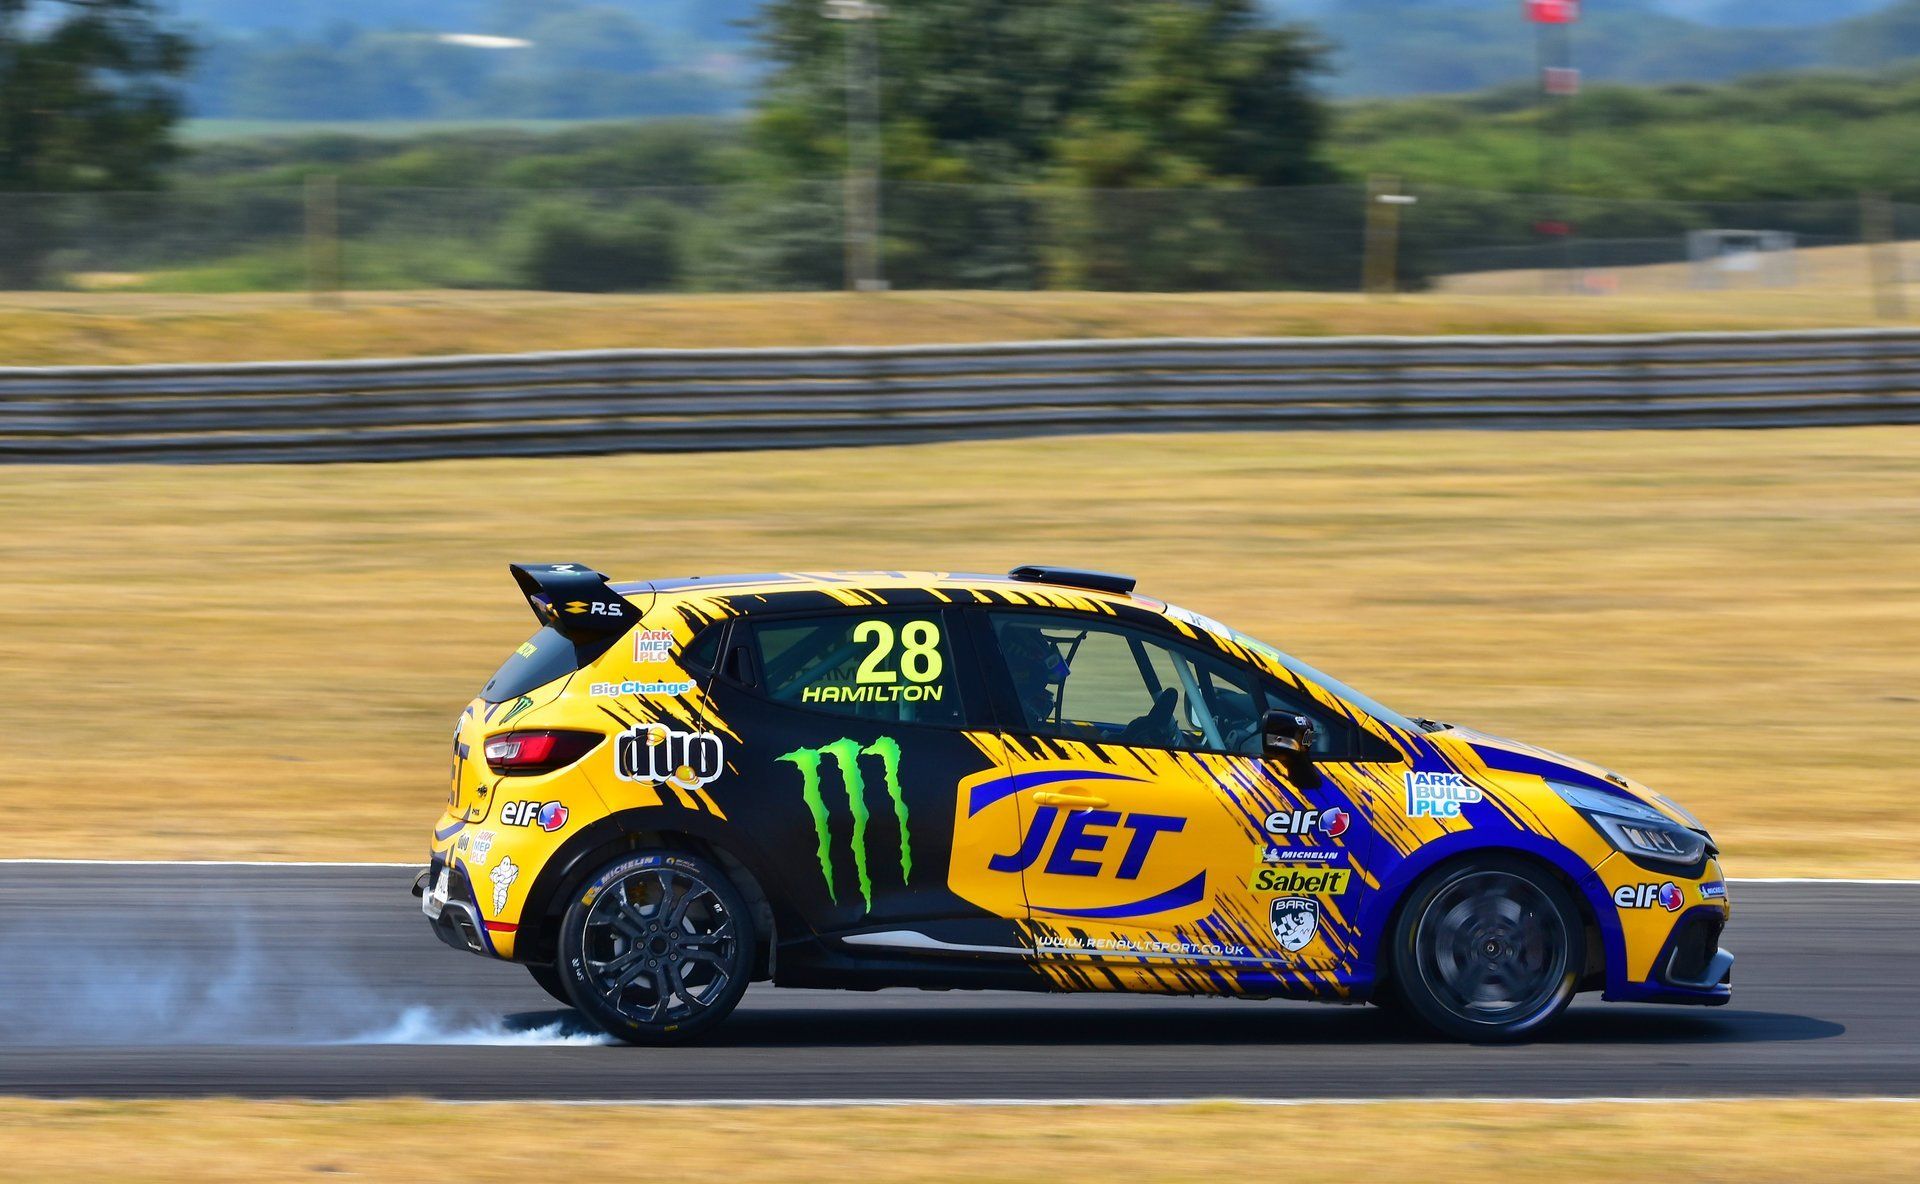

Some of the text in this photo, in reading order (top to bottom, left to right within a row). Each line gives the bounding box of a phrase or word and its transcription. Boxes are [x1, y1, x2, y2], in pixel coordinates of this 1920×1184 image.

[591, 601, 623, 616] R.S.
[640, 631, 672, 641] ARK
[640, 641, 672, 651] MEP
[853, 620, 943, 684] 28
[640, 651, 668, 661] PLC
[802, 685, 943, 702] HAMILTON
[1415, 774, 1462, 786] ARK
[1416, 787, 1481, 802] BUILD
[501, 801, 540, 826] elf
[1416, 801, 1459, 816] PLC
[1265, 810, 1318, 834] elf
[987, 806, 1188, 880] JET
[1281, 851, 1339, 860] MICHELIN
[601, 856, 655, 884] MICHELIN
[1255, 869, 1342, 892] Sabelt
[1614, 883, 1659, 908] elf
[1275, 900, 1315, 912] BARC
[1039, 936, 1245, 955] WWW.RENAULTSPORT.CO.UK
